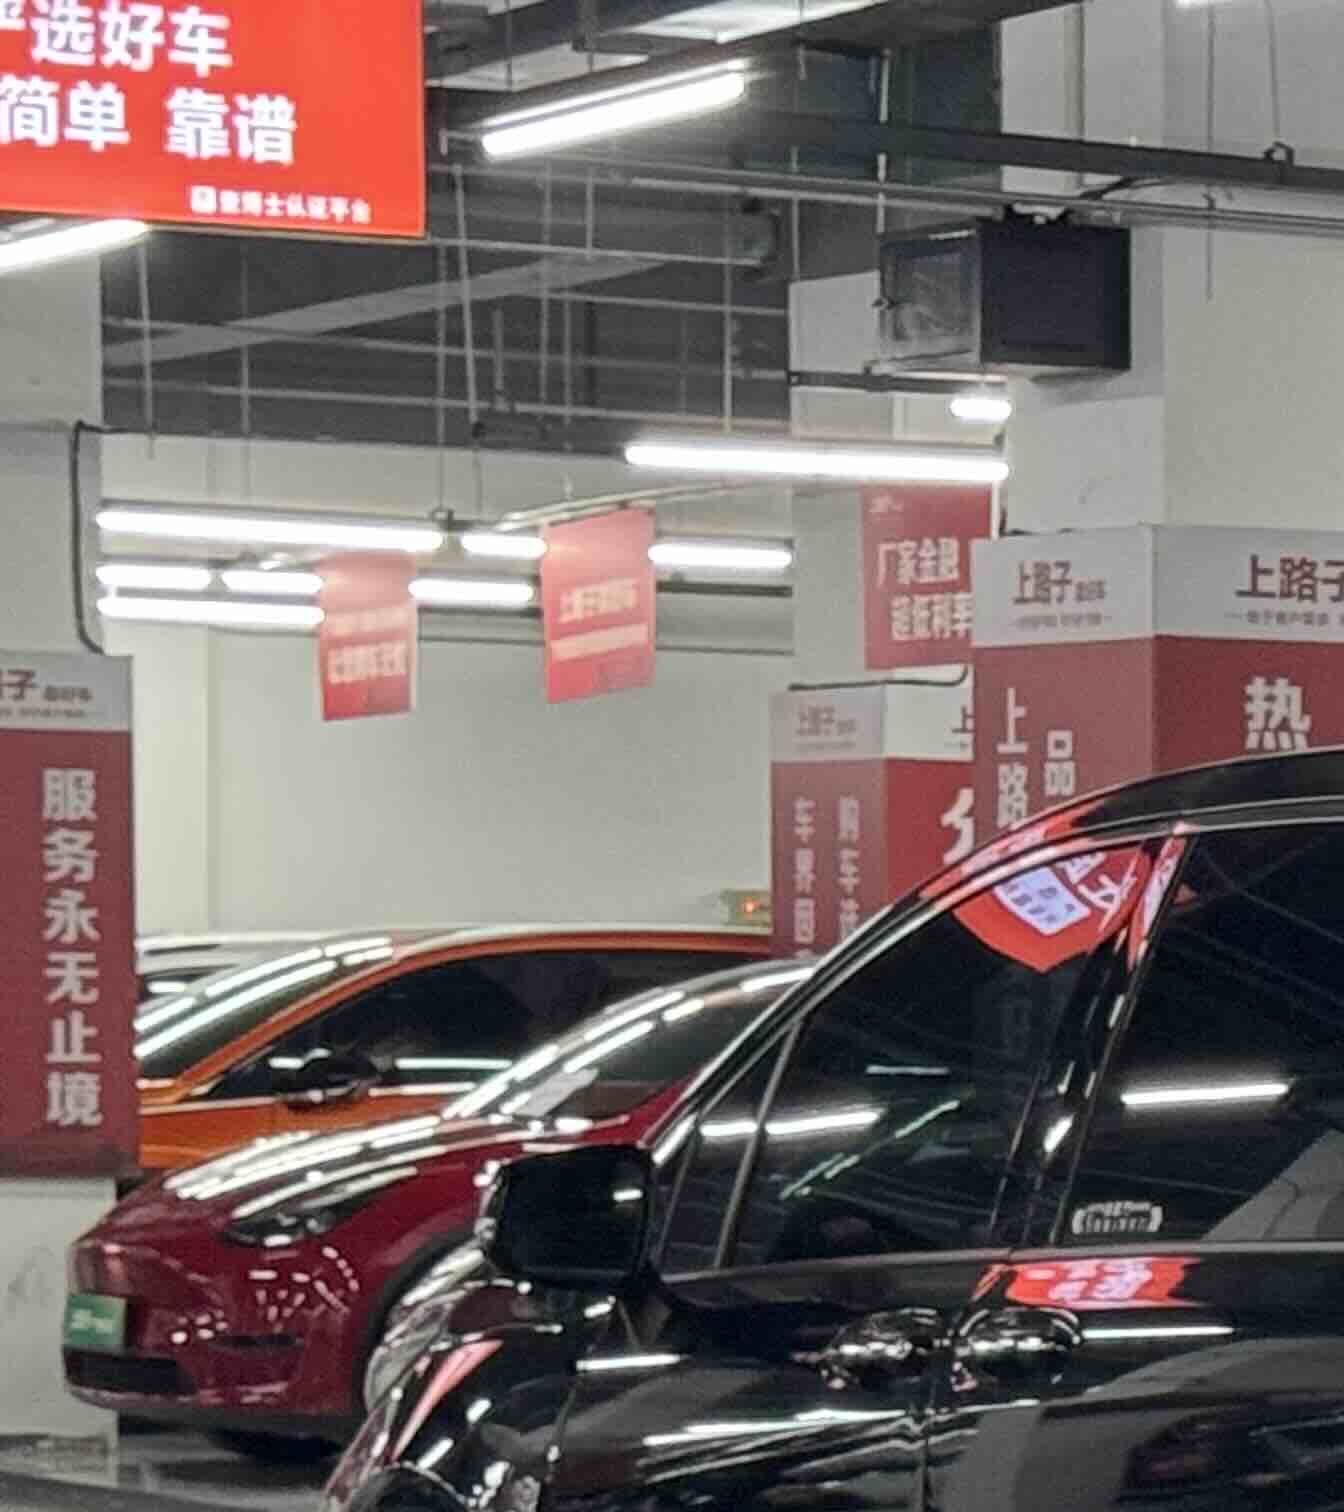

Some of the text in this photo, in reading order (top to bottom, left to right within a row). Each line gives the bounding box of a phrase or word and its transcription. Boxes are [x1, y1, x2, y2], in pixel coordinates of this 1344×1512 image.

[0, 74, 297, 165] 简单 靠谱
[0, 667, 36, 702] 子
[42, 768, 103, 1126] 服务永无止境
